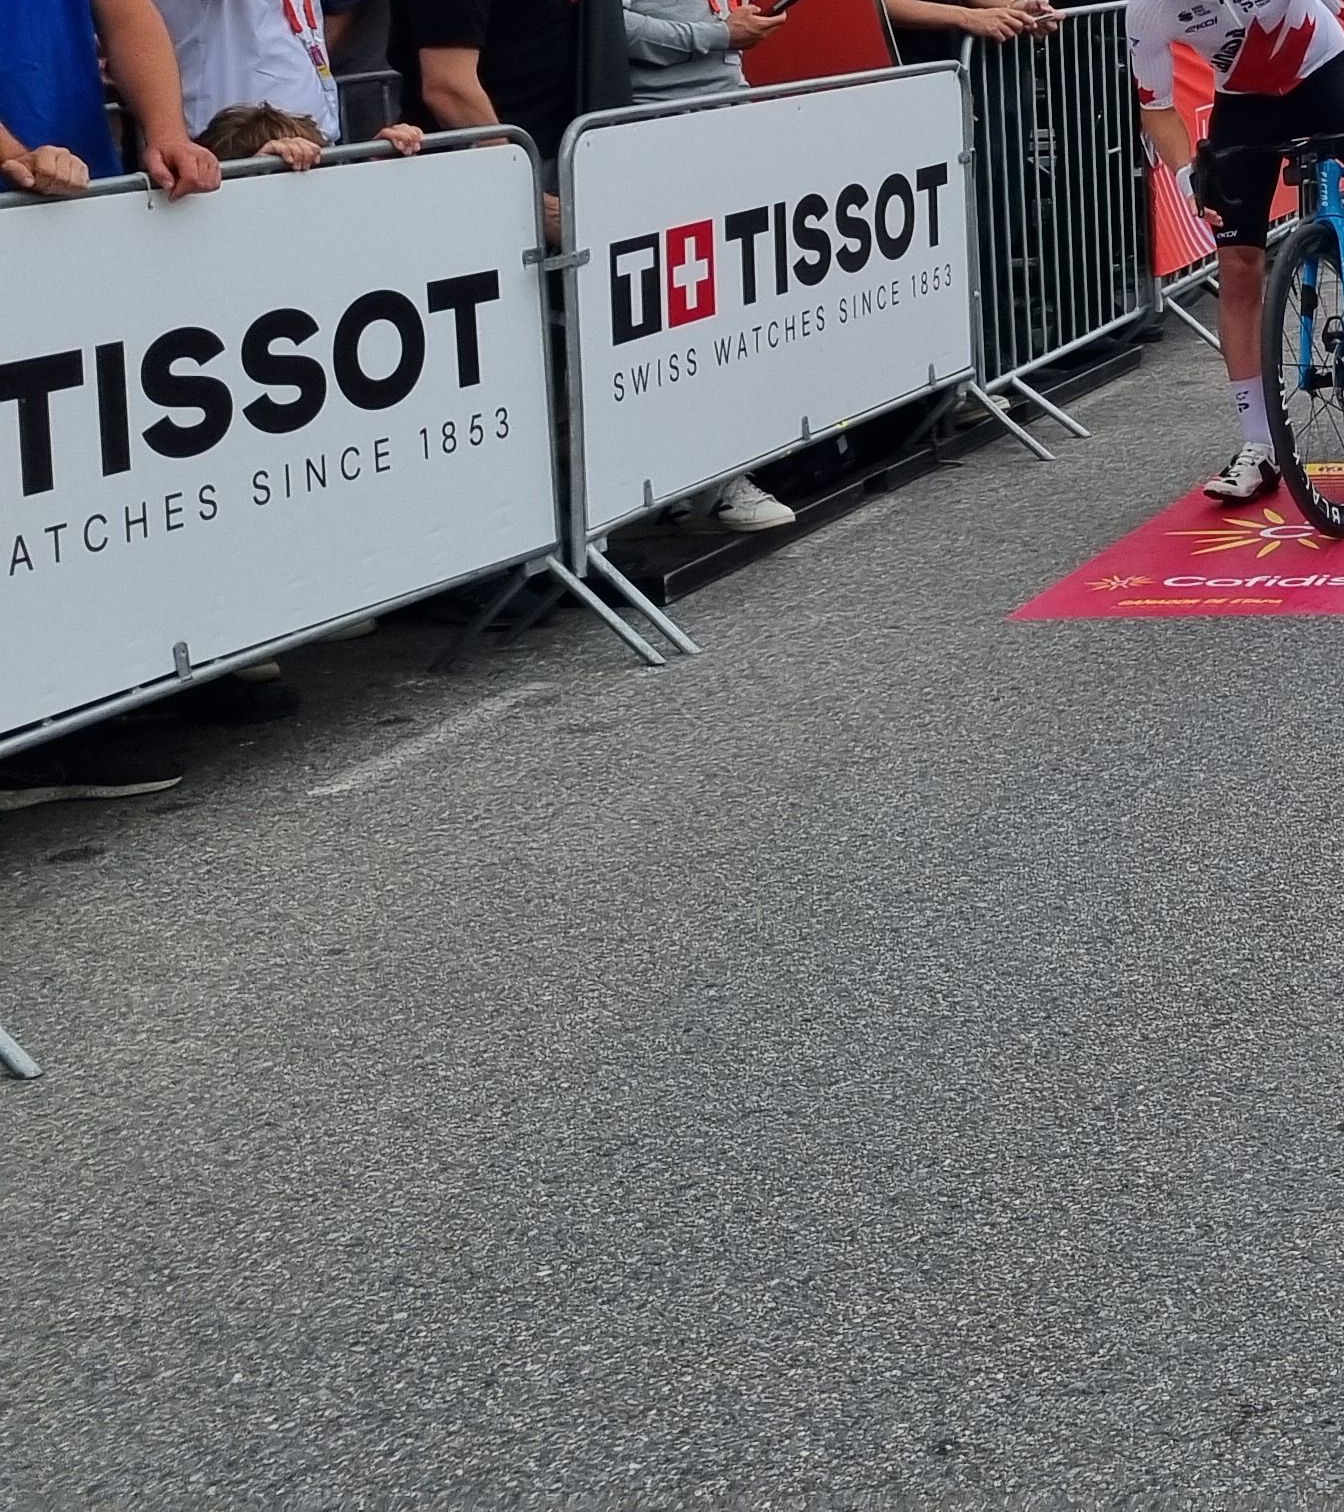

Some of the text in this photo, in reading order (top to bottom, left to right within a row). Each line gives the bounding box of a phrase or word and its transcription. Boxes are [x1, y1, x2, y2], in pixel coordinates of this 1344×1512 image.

[725, 162, 948, 306] TISSOT
[0, 270, 500, 497] TISSOT
[613, 263, 953, 402] SWISS WATCHES SINCE 1853
[8, 406, 512, 576] ATCHES SINCE 1853
